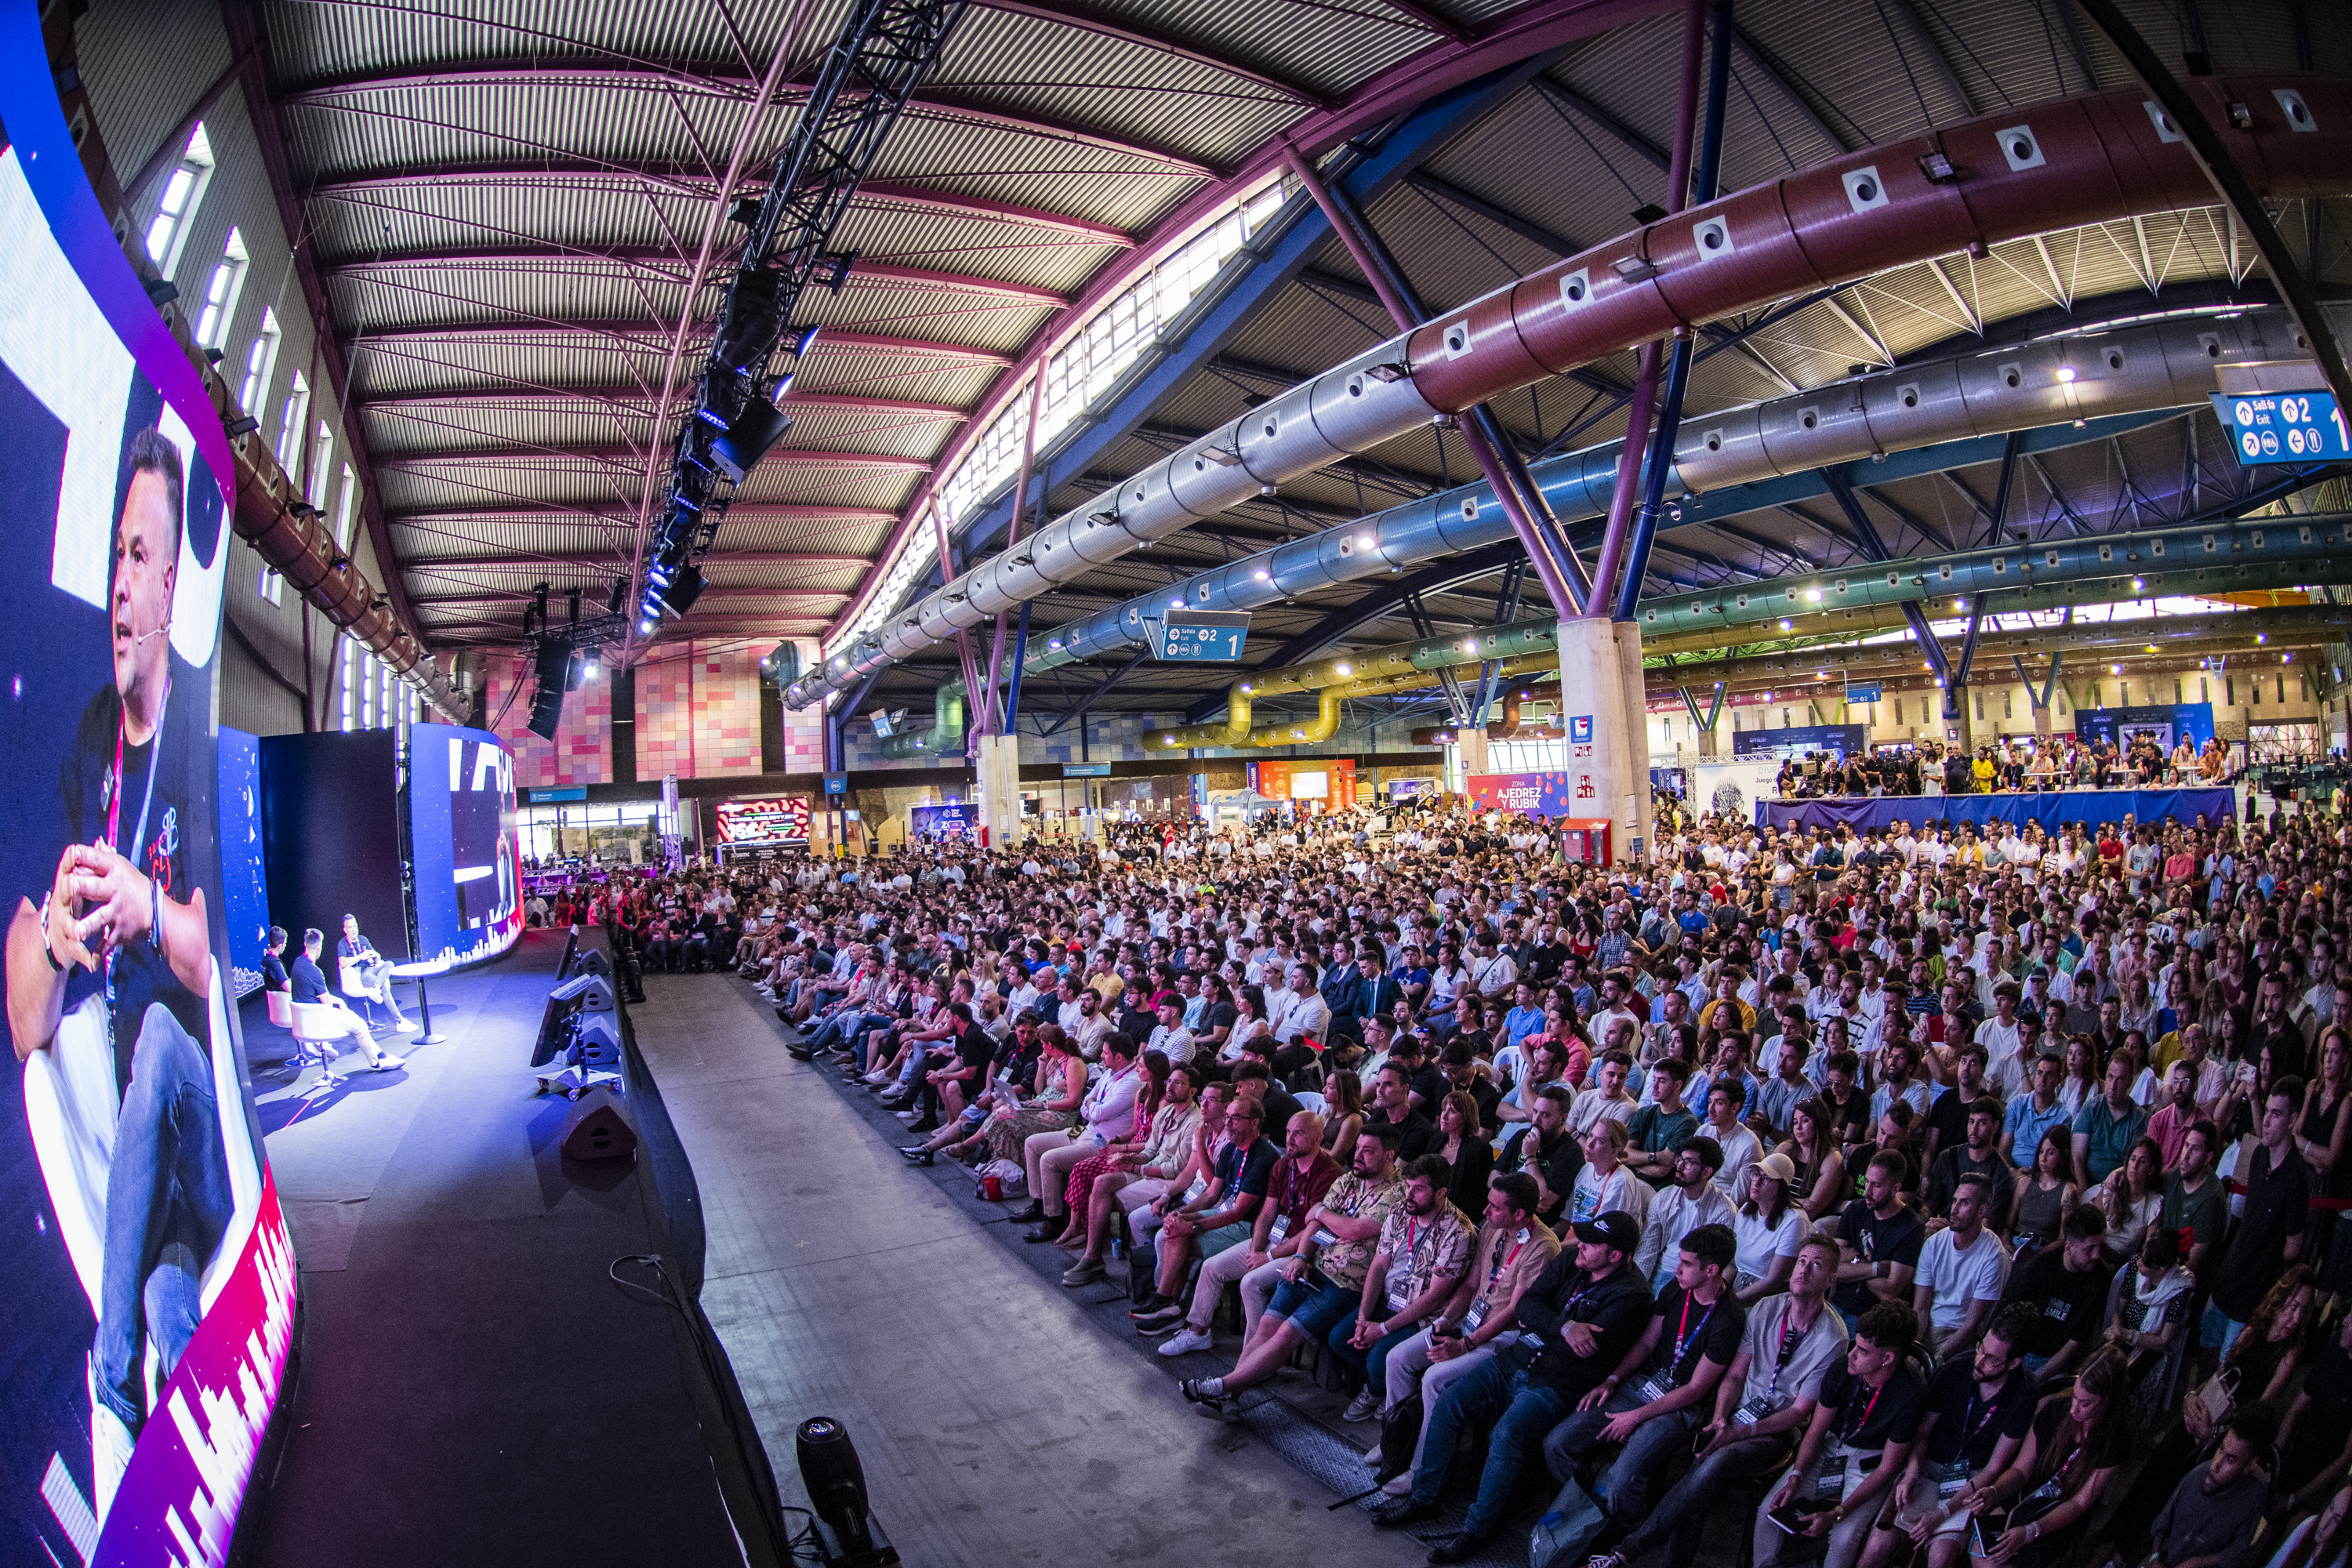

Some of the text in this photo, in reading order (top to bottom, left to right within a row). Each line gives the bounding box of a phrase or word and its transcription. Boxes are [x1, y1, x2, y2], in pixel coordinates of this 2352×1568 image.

[2252, 397, 2312, 423] Salida 2
[2256, 415, 2270, 425] Exit
[2330, 407, 2350, 452] 1
[1209, 629, 1217, 641] 2
[1229, 635, 1238, 657] 1
[1871, 691, 1877, 701] 1
[1497, 787, 1542, 799] AJEDREZ
[1501, 797, 1541, 809] Y RUBIK
[2132, 855, 2143, 864] VANS
[2044, 1307, 2067, 1321] SMILE
